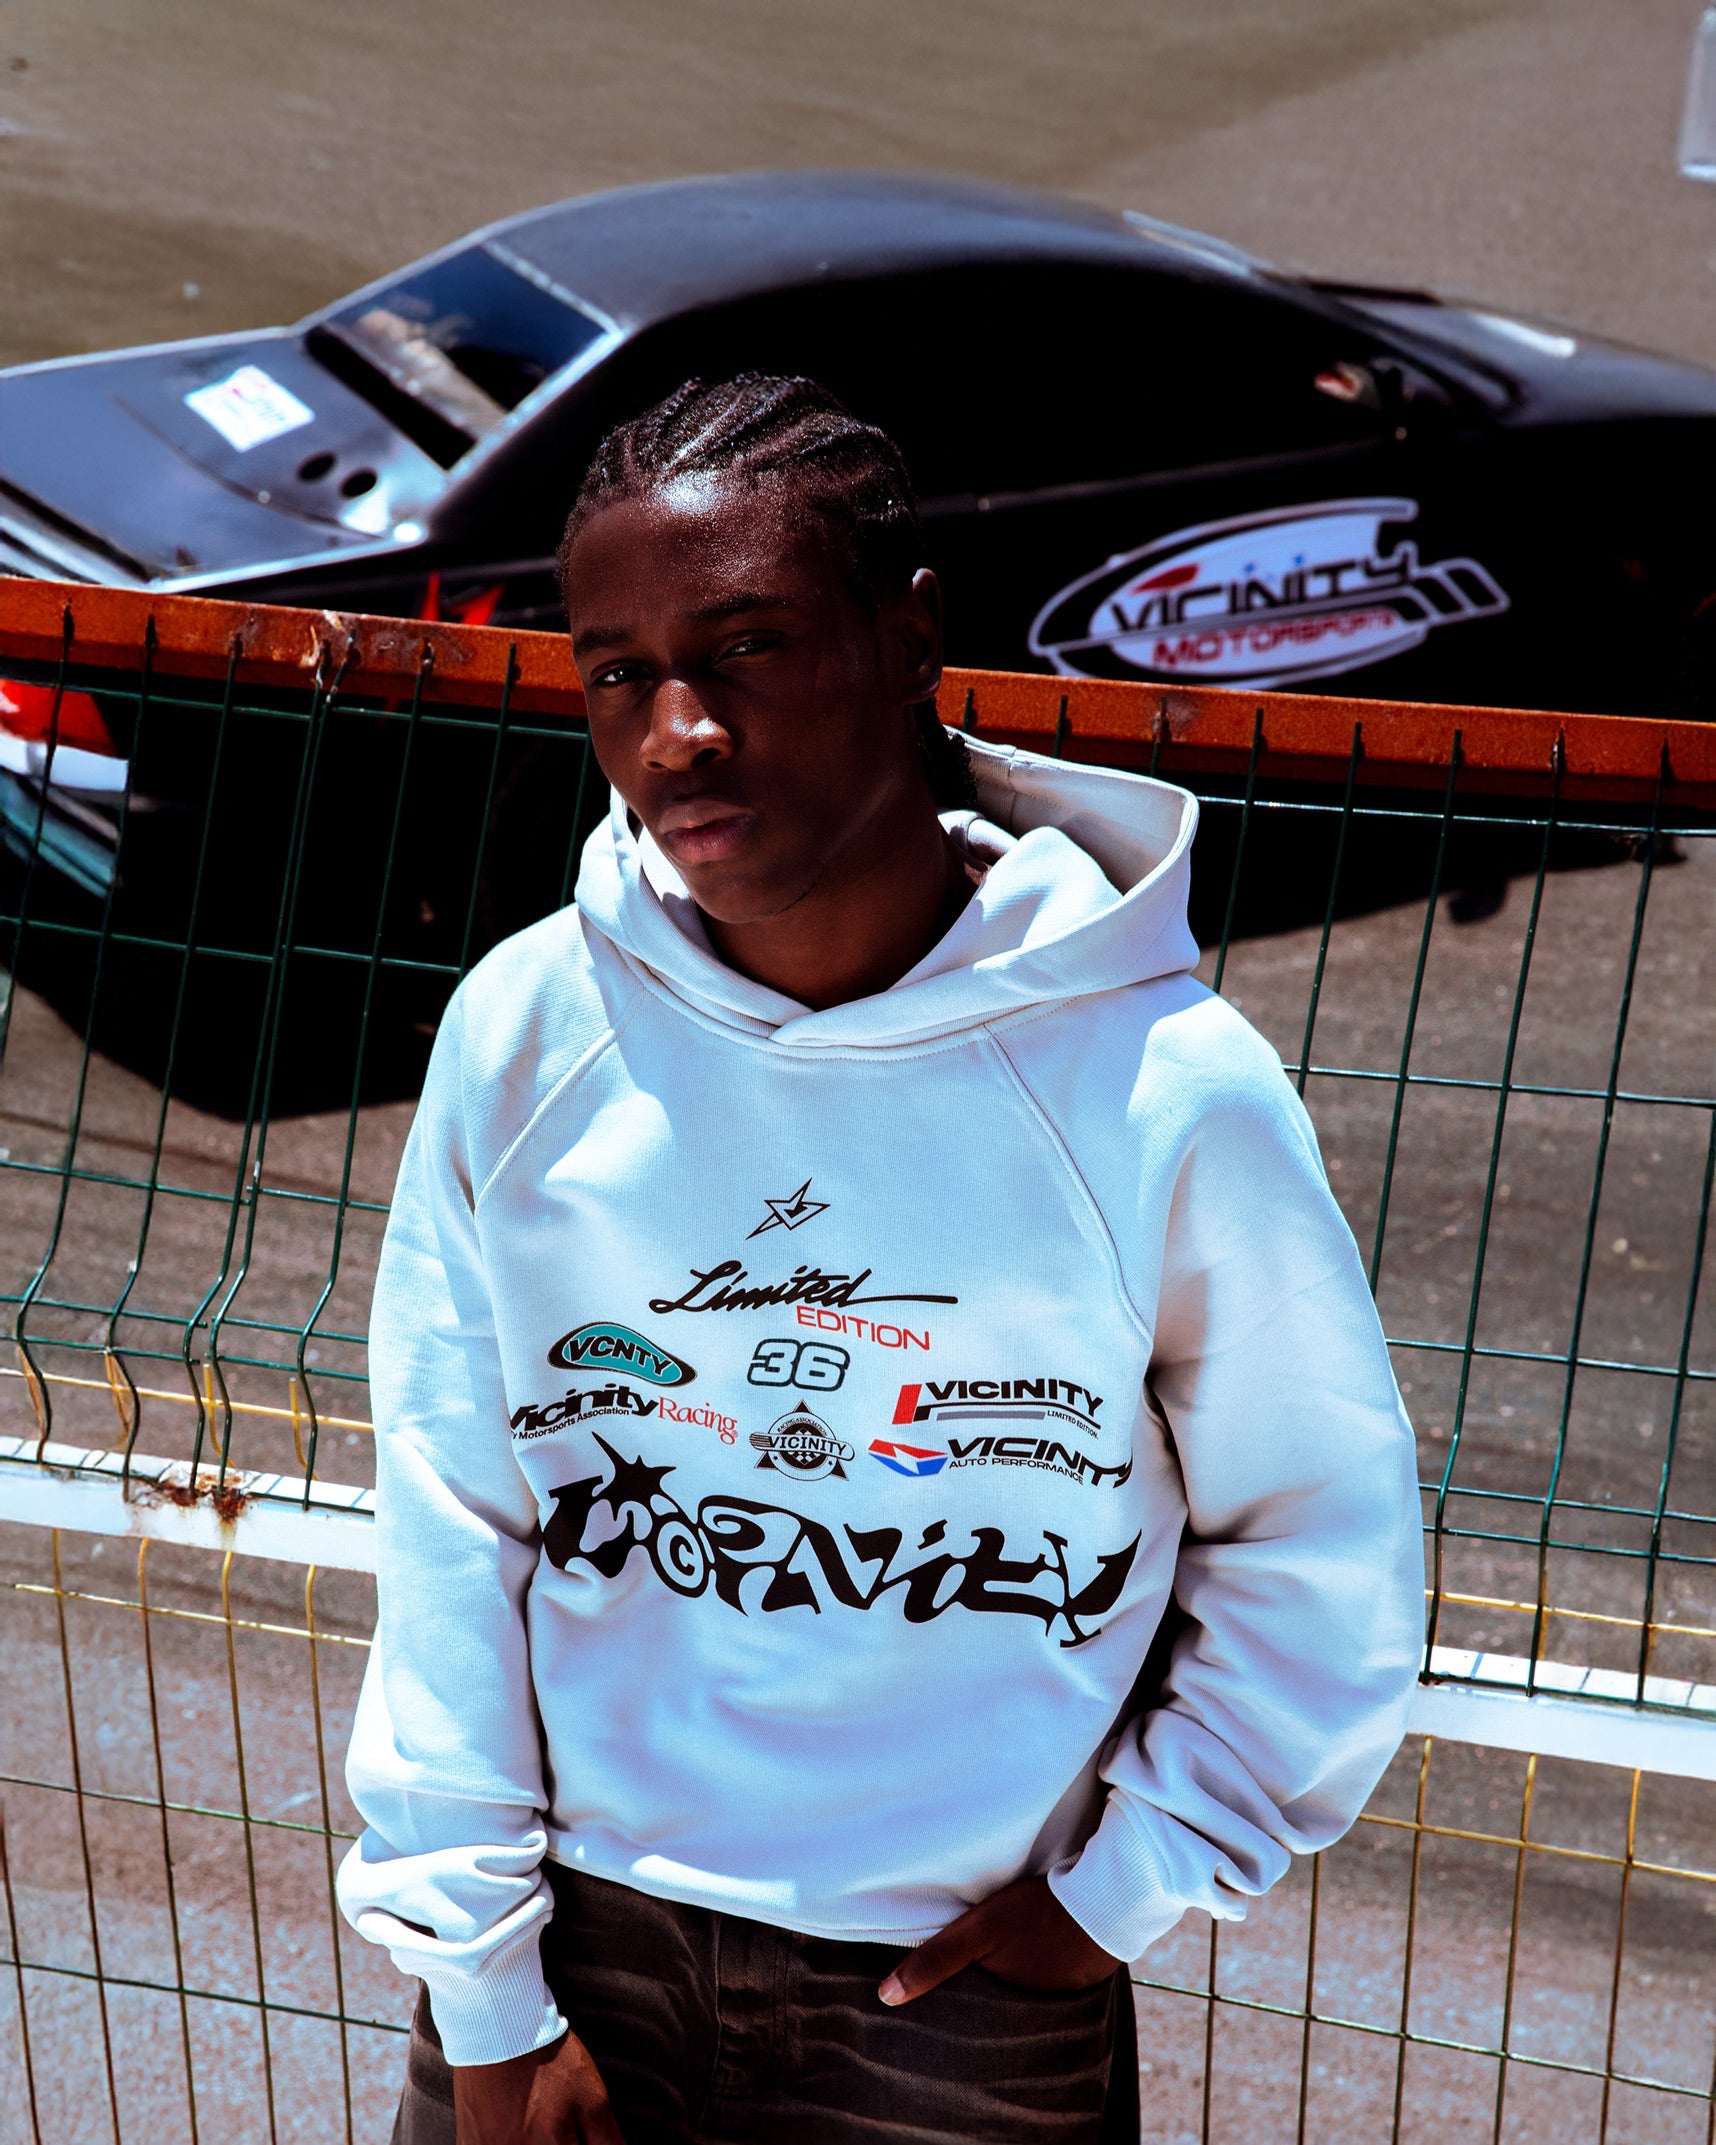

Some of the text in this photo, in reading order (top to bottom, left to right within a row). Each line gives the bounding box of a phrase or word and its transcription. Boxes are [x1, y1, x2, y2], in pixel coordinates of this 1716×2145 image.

[1109, 540, 1418, 632] VICINITY
[648, 1260, 958, 1313] Limited
[796, 1305, 930, 1351] EDITION
[568, 1335, 672, 1376] VCNTY
[747, 1338, 851, 1391] 36
[925, 1378, 1104, 1418] VICINITY
[1047, 1410, 1077, 1425] LIMITED
[518, 1416, 576, 1440] Motorsports
[577, 1407, 630, 1424] Association
[769, 1436, 847, 1456] VICINITY
[949, 1457, 1084, 1486] AUTO PERFORMANCE
